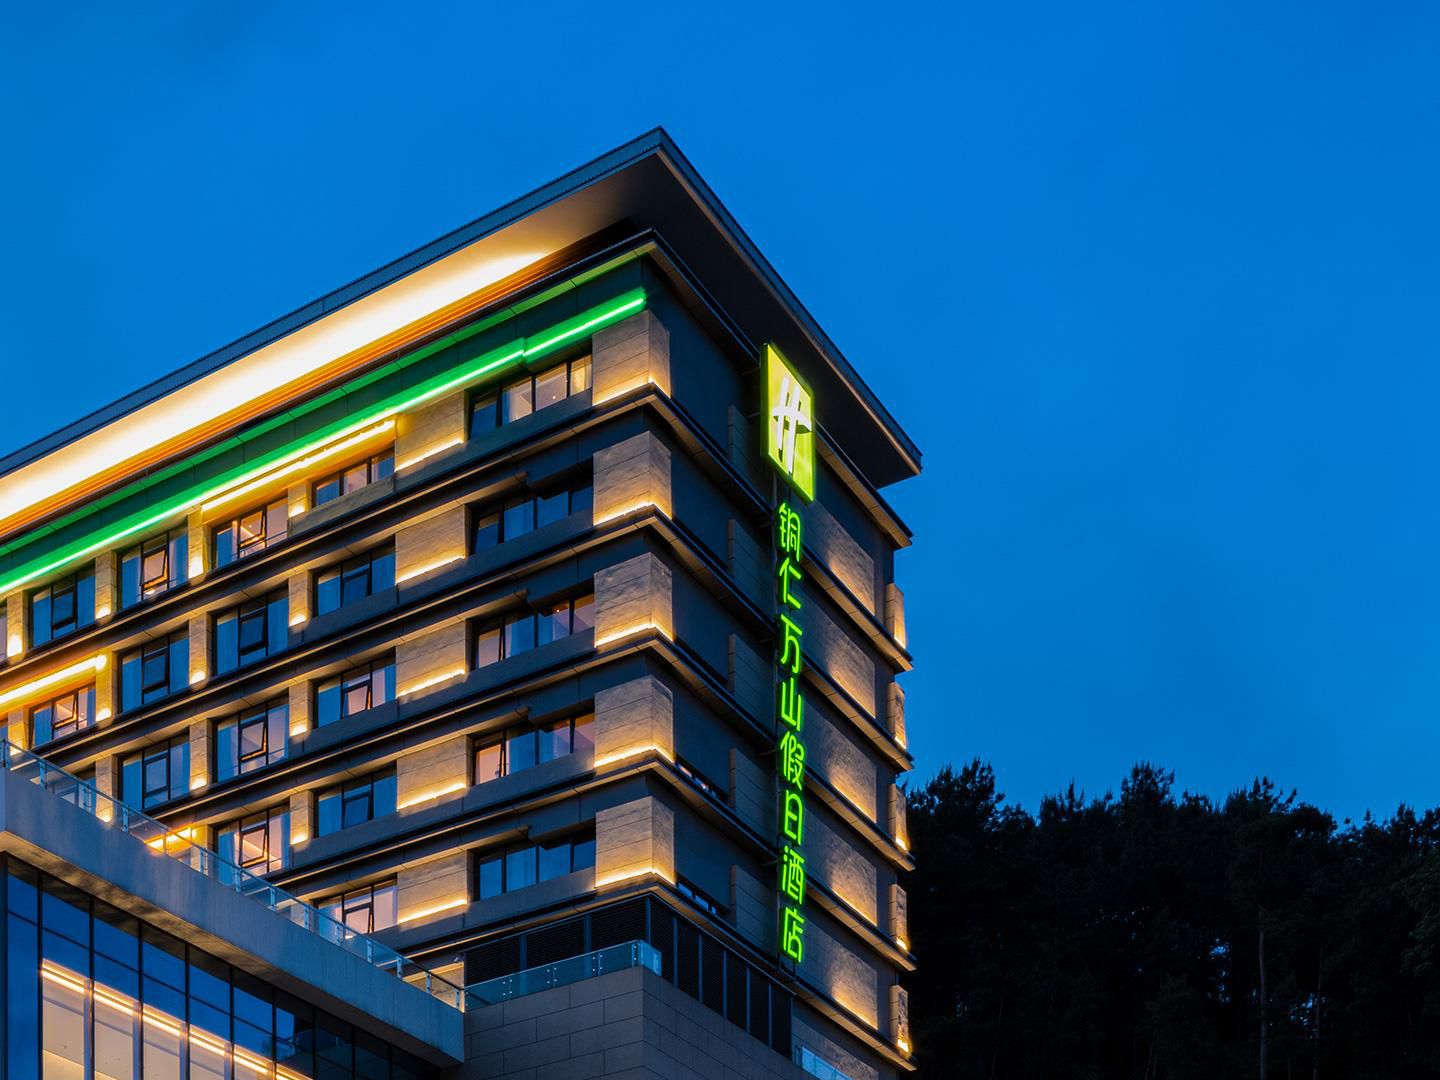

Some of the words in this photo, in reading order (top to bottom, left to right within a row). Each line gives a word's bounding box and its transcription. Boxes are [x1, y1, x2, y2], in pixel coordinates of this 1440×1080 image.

[778, 502, 805, 964] 铜仁万山假日酒店
